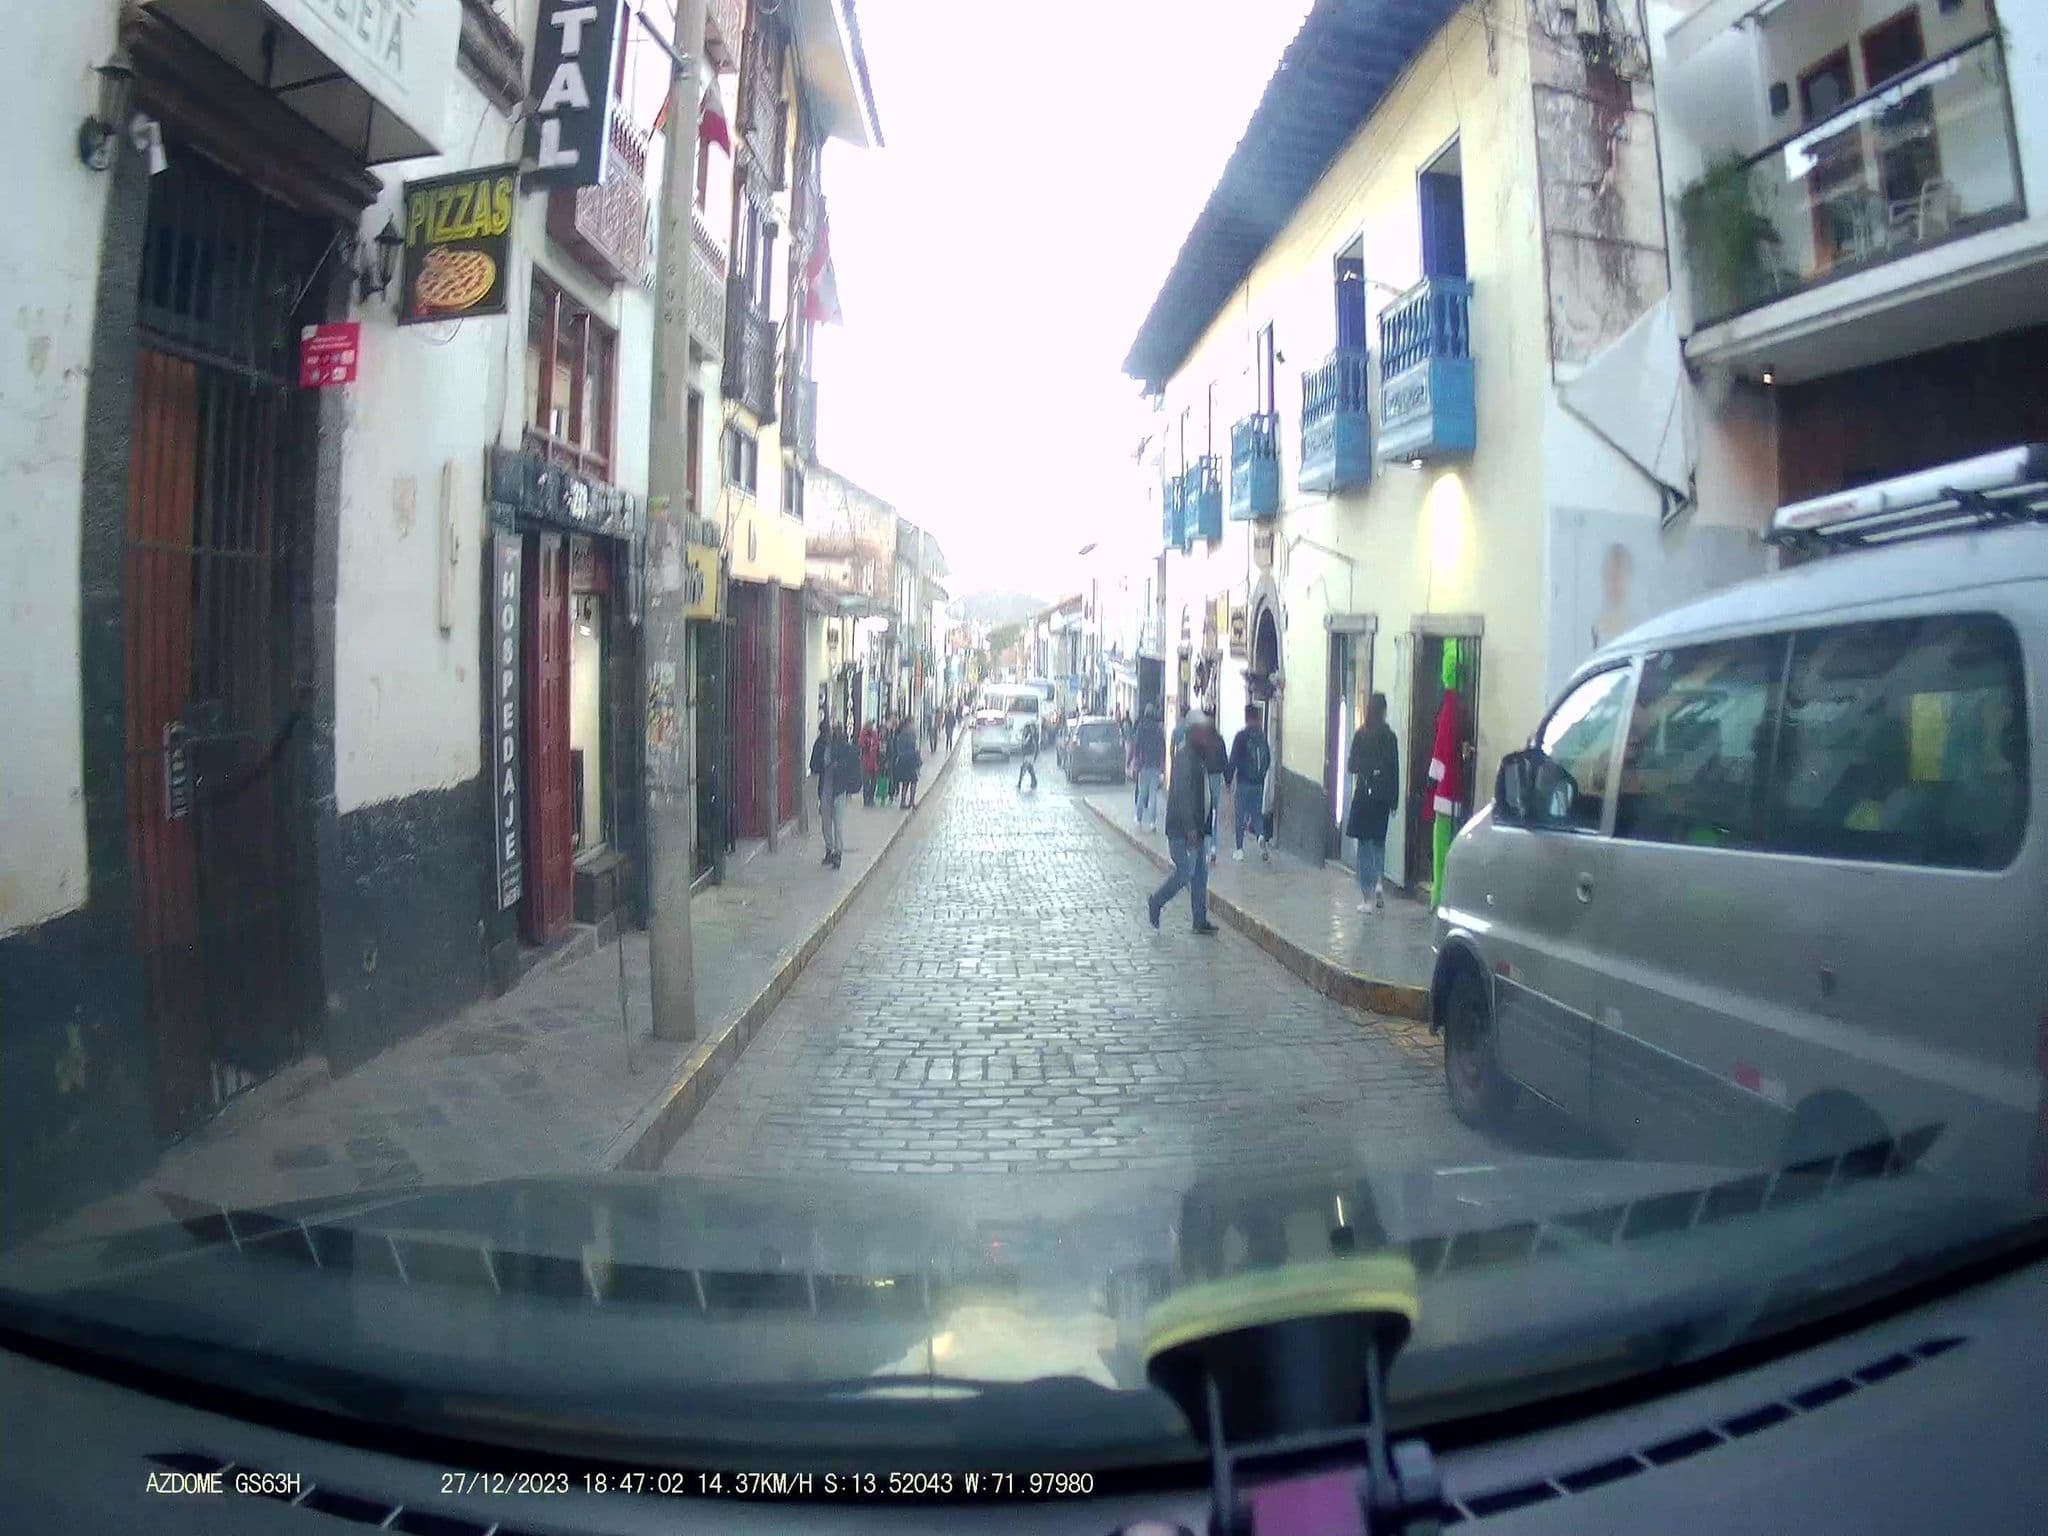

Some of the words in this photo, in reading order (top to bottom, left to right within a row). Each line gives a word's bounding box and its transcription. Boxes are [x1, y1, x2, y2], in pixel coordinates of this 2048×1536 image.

[538, 0, 598, 169] TAL
[406, 176, 513, 248] PIZZAS
[502, 570, 516, 861] HOSPEDAJE
